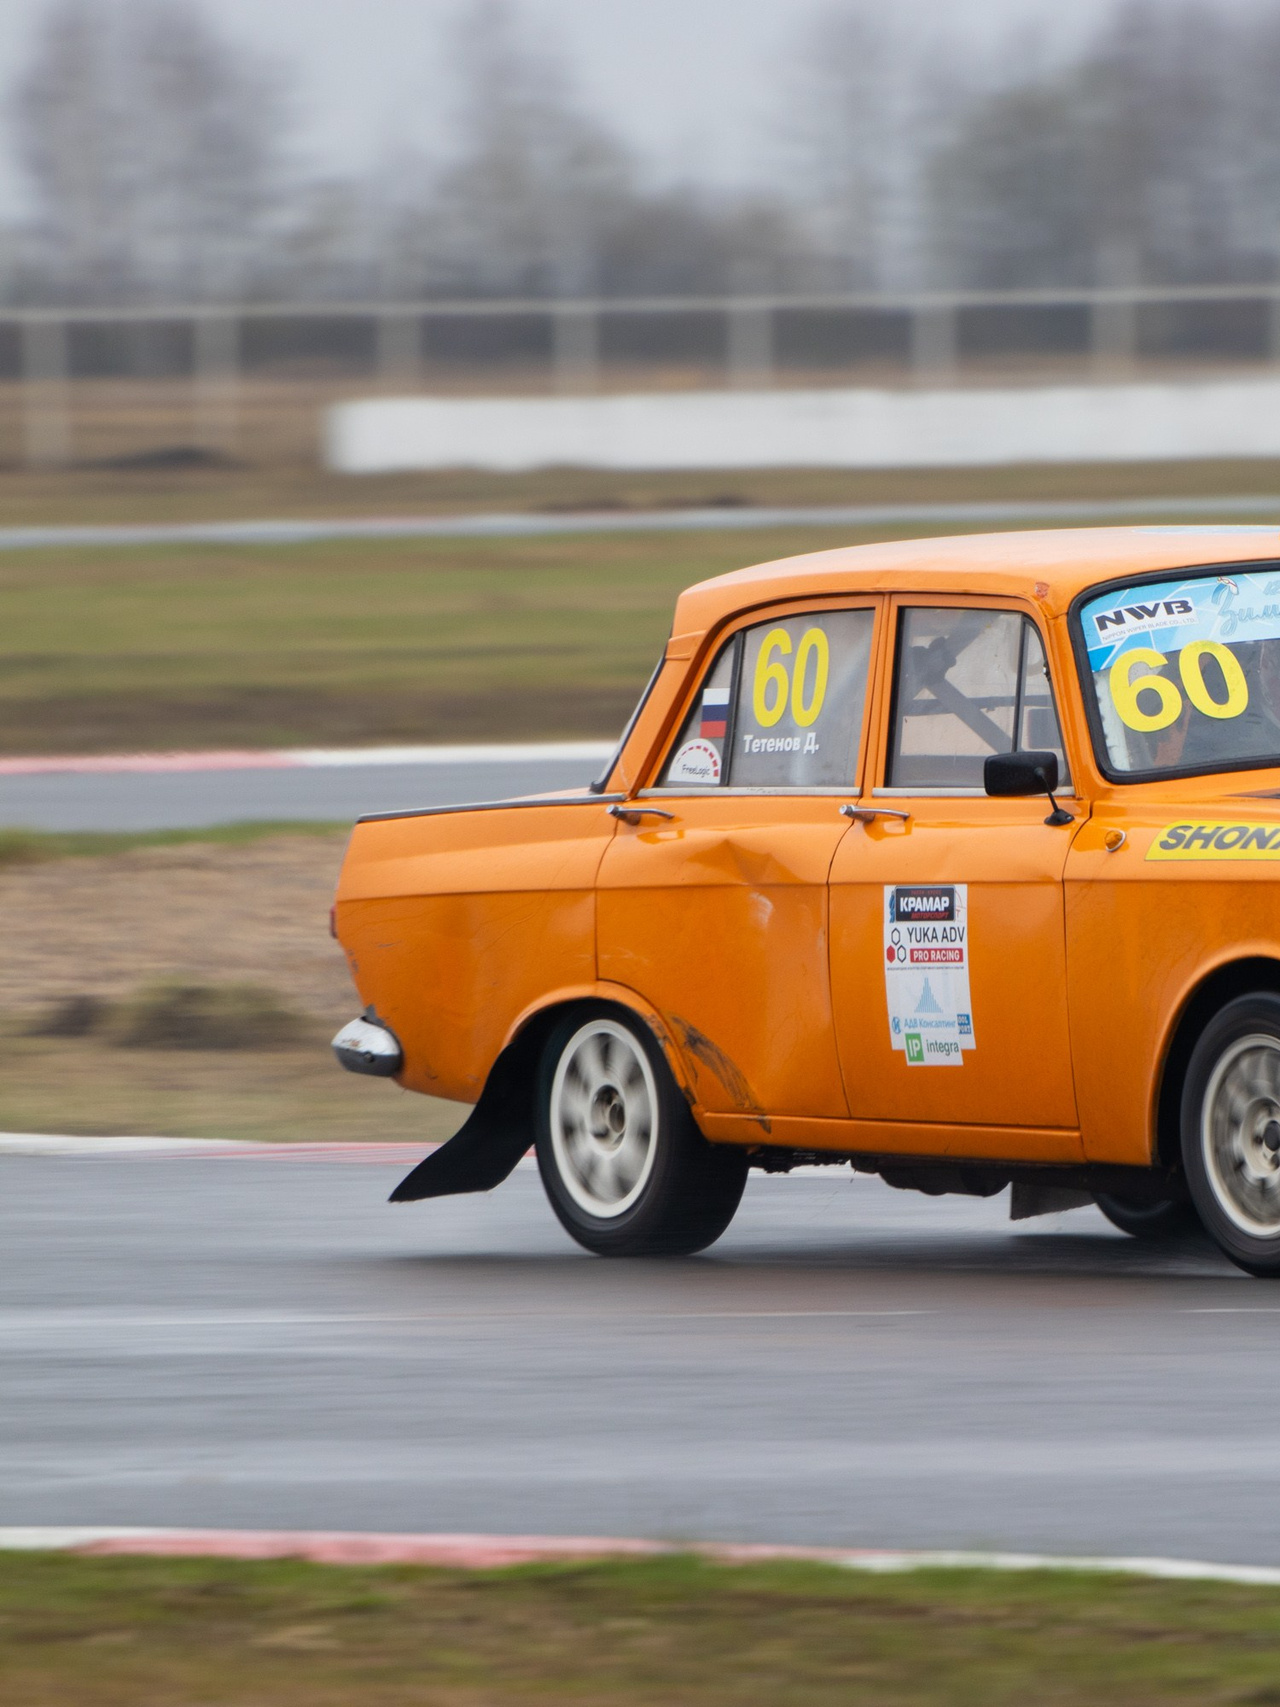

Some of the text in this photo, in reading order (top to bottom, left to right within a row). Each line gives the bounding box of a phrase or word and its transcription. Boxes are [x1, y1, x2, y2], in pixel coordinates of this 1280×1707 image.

[1095, 600, 1193, 631] NWB
[1102, 629, 1126, 641] NIPPON
[1127, 624, 1147, 634] WIPER
[1147, 620, 1169, 630] BLADE
[753, 628, 829, 728] 60
[1109, 640, 1249, 733] 60
[743, 732, 820, 754] Тетенов Д.
[900, 896, 949, 912] КРАМАР
[907, 926, 965, 943] YUKA ADV
[913, 950, 960, 961] PRO RACING
[908, 1039, 959, 1057] IP integra
